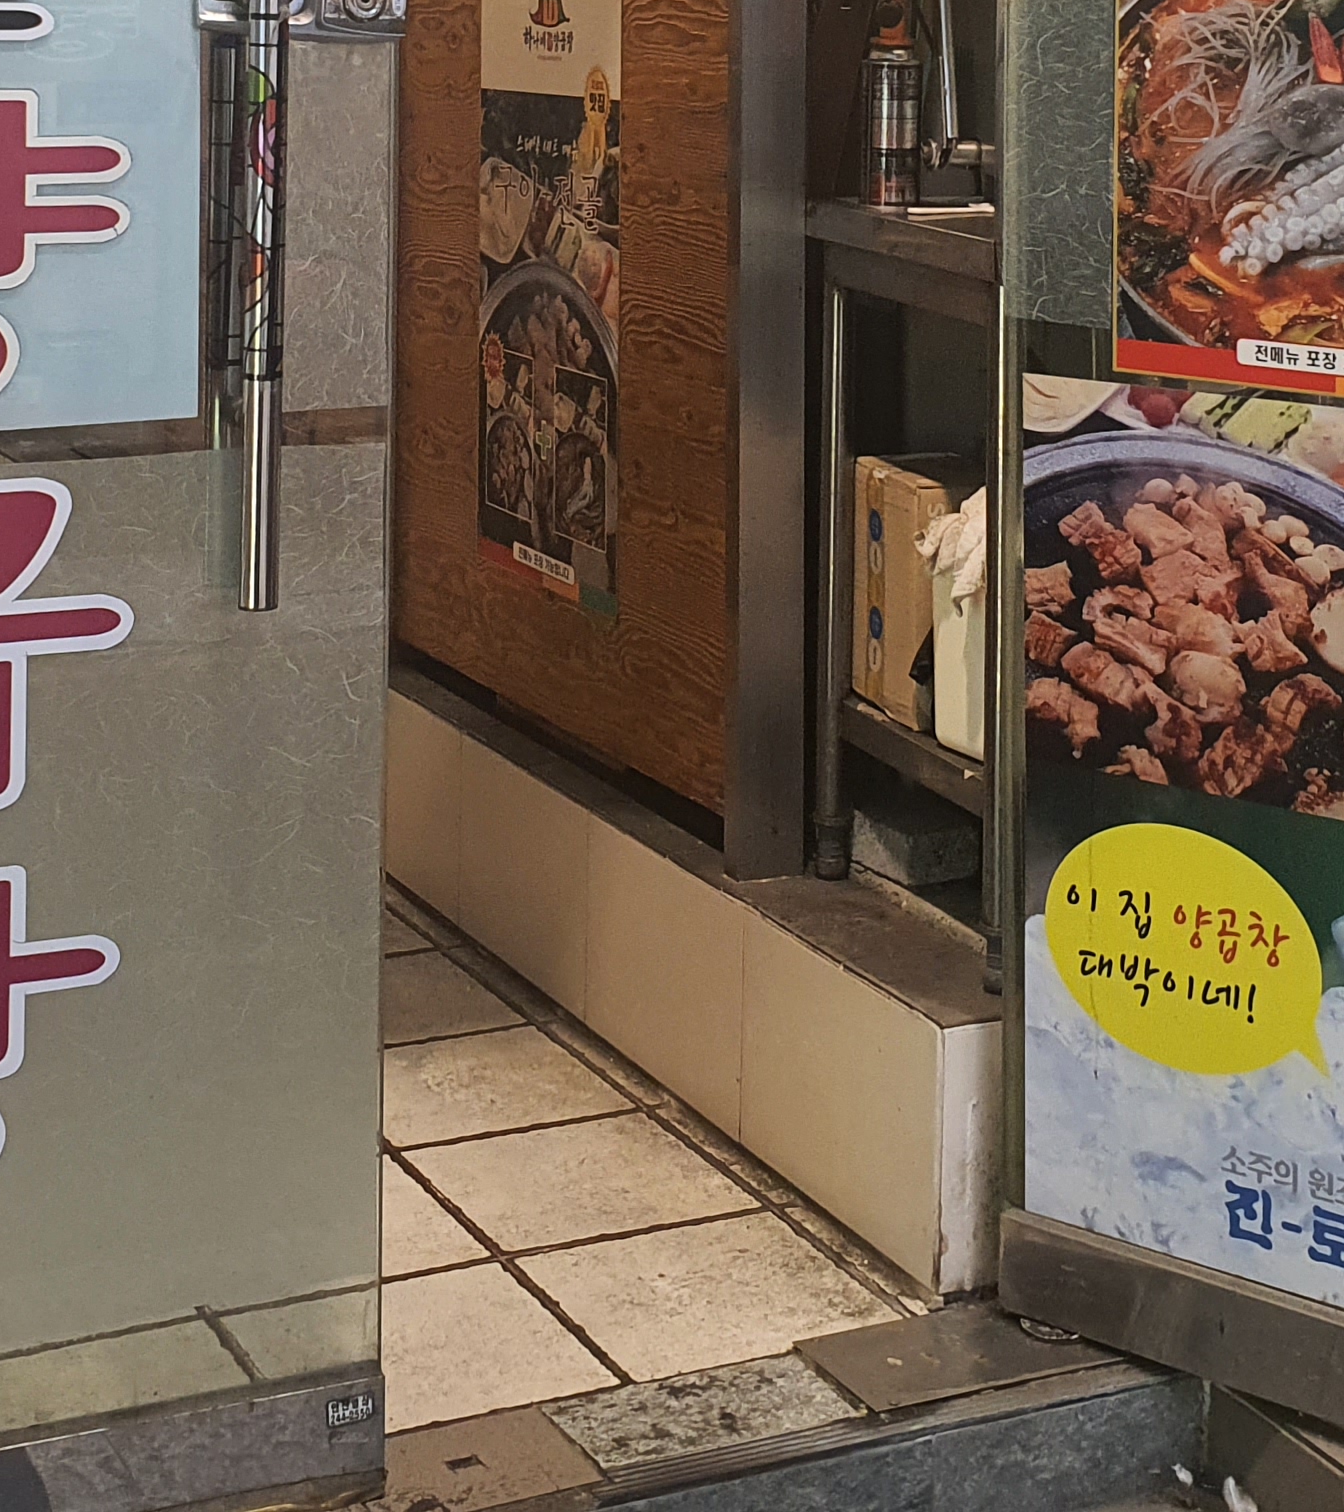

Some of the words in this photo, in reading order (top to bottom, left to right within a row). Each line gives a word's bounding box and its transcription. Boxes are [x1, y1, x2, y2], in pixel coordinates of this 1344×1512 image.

[1253, 343, 1301, 368] 전메뉴
[1306, 351, 1337, 371] 포장
[1066, 884, 1098, 912] 이
[1118, 889, 1152, 939] 집
[1173, 904, 1291, 967] 양곱창
[1078, 949, 1257, 1024] 대박이네!
[1220, 1145, 1299, 1193] 소주의
